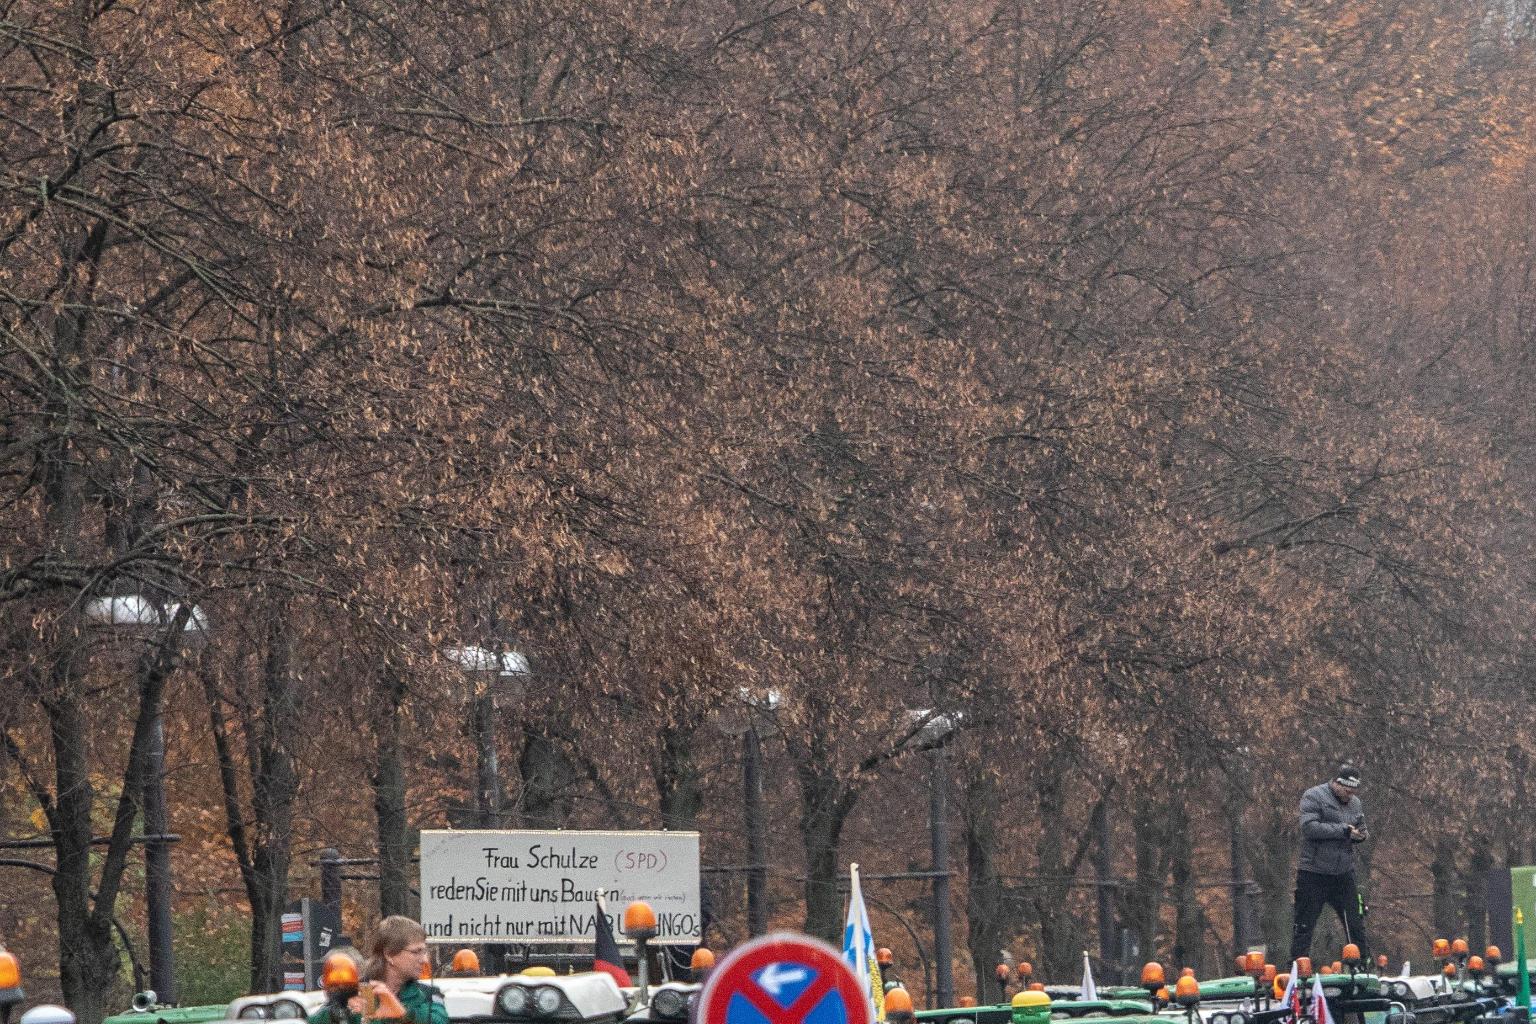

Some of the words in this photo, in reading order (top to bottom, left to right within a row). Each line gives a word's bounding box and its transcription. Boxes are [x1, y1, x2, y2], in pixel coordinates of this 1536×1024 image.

[482, 847, 520, 869] Frau
[527, 844, 599, 869] Schulze
[614, 849, 668, 873] (SPD)
[501, 880, 528, 903] mit
[530, 888, 558, 903] uns
[561, 878, 620, 903] Bauern
[423, 913, 453, 937] und
[459, 914, 501, 936] nicht
[506, 920, 534, 936] nur
[537, 915, 566, 936] mit
